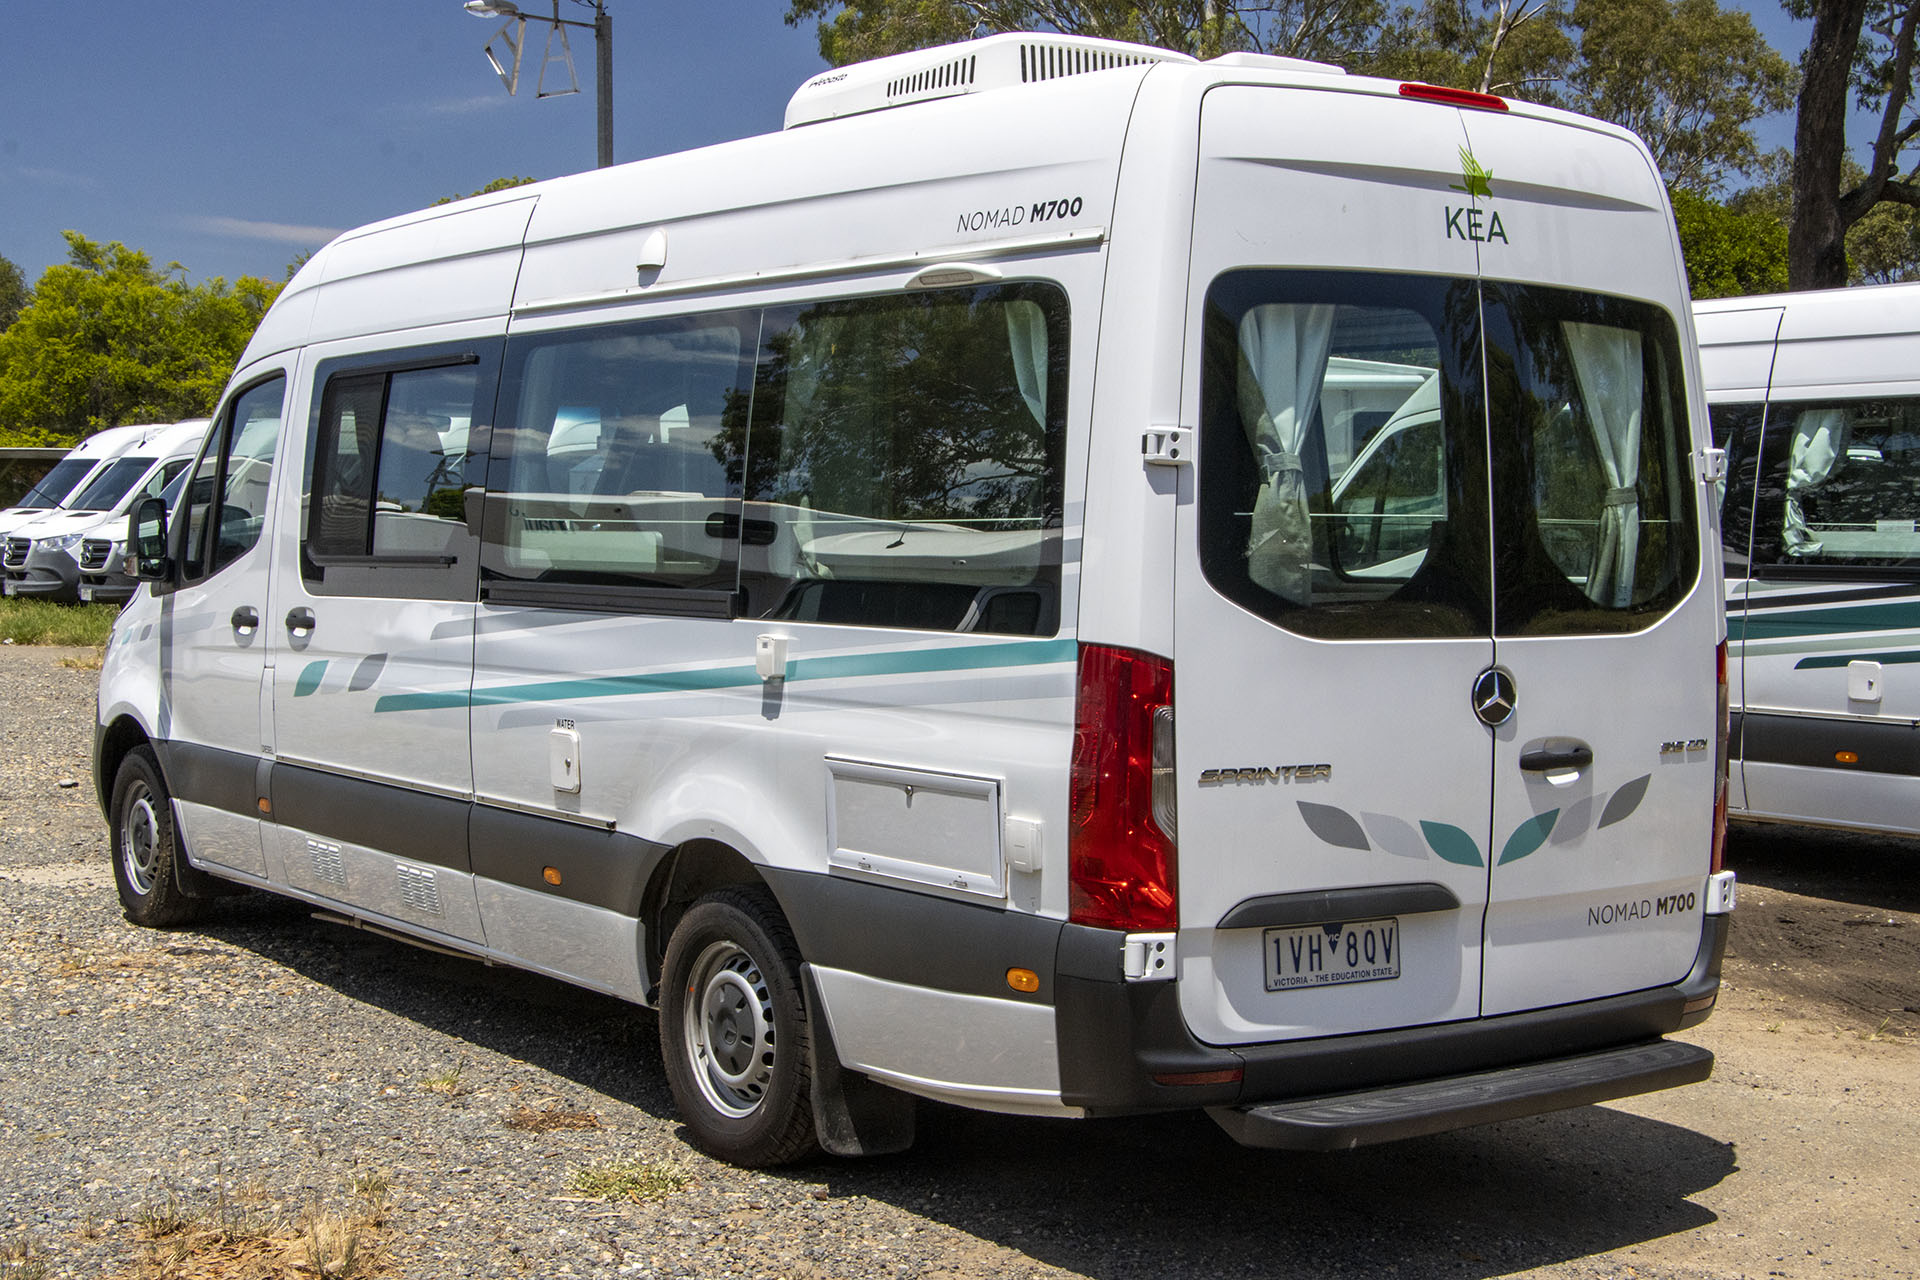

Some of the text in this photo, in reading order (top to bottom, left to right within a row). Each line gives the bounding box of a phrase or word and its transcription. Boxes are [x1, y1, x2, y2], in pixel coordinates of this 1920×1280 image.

[957, 196, 1083, 232] NOMAD M700
[1445, 206, 1509, 244] KEA
[556, 719, 575, 730] WATER
[1198, 764, 1332, 785] SPRINTER
[1588, 892, 1696, 926] NOMAD M700
[1274, 927, 1393, 975] 1VH 8QV
[1274, 976, 1309, 987] VICTORIA
[1315, 974, 1329, 983] THE
[1331, 969, 1371, 981] EDUCATION
[1372, 967, 1393, 977] STATE
